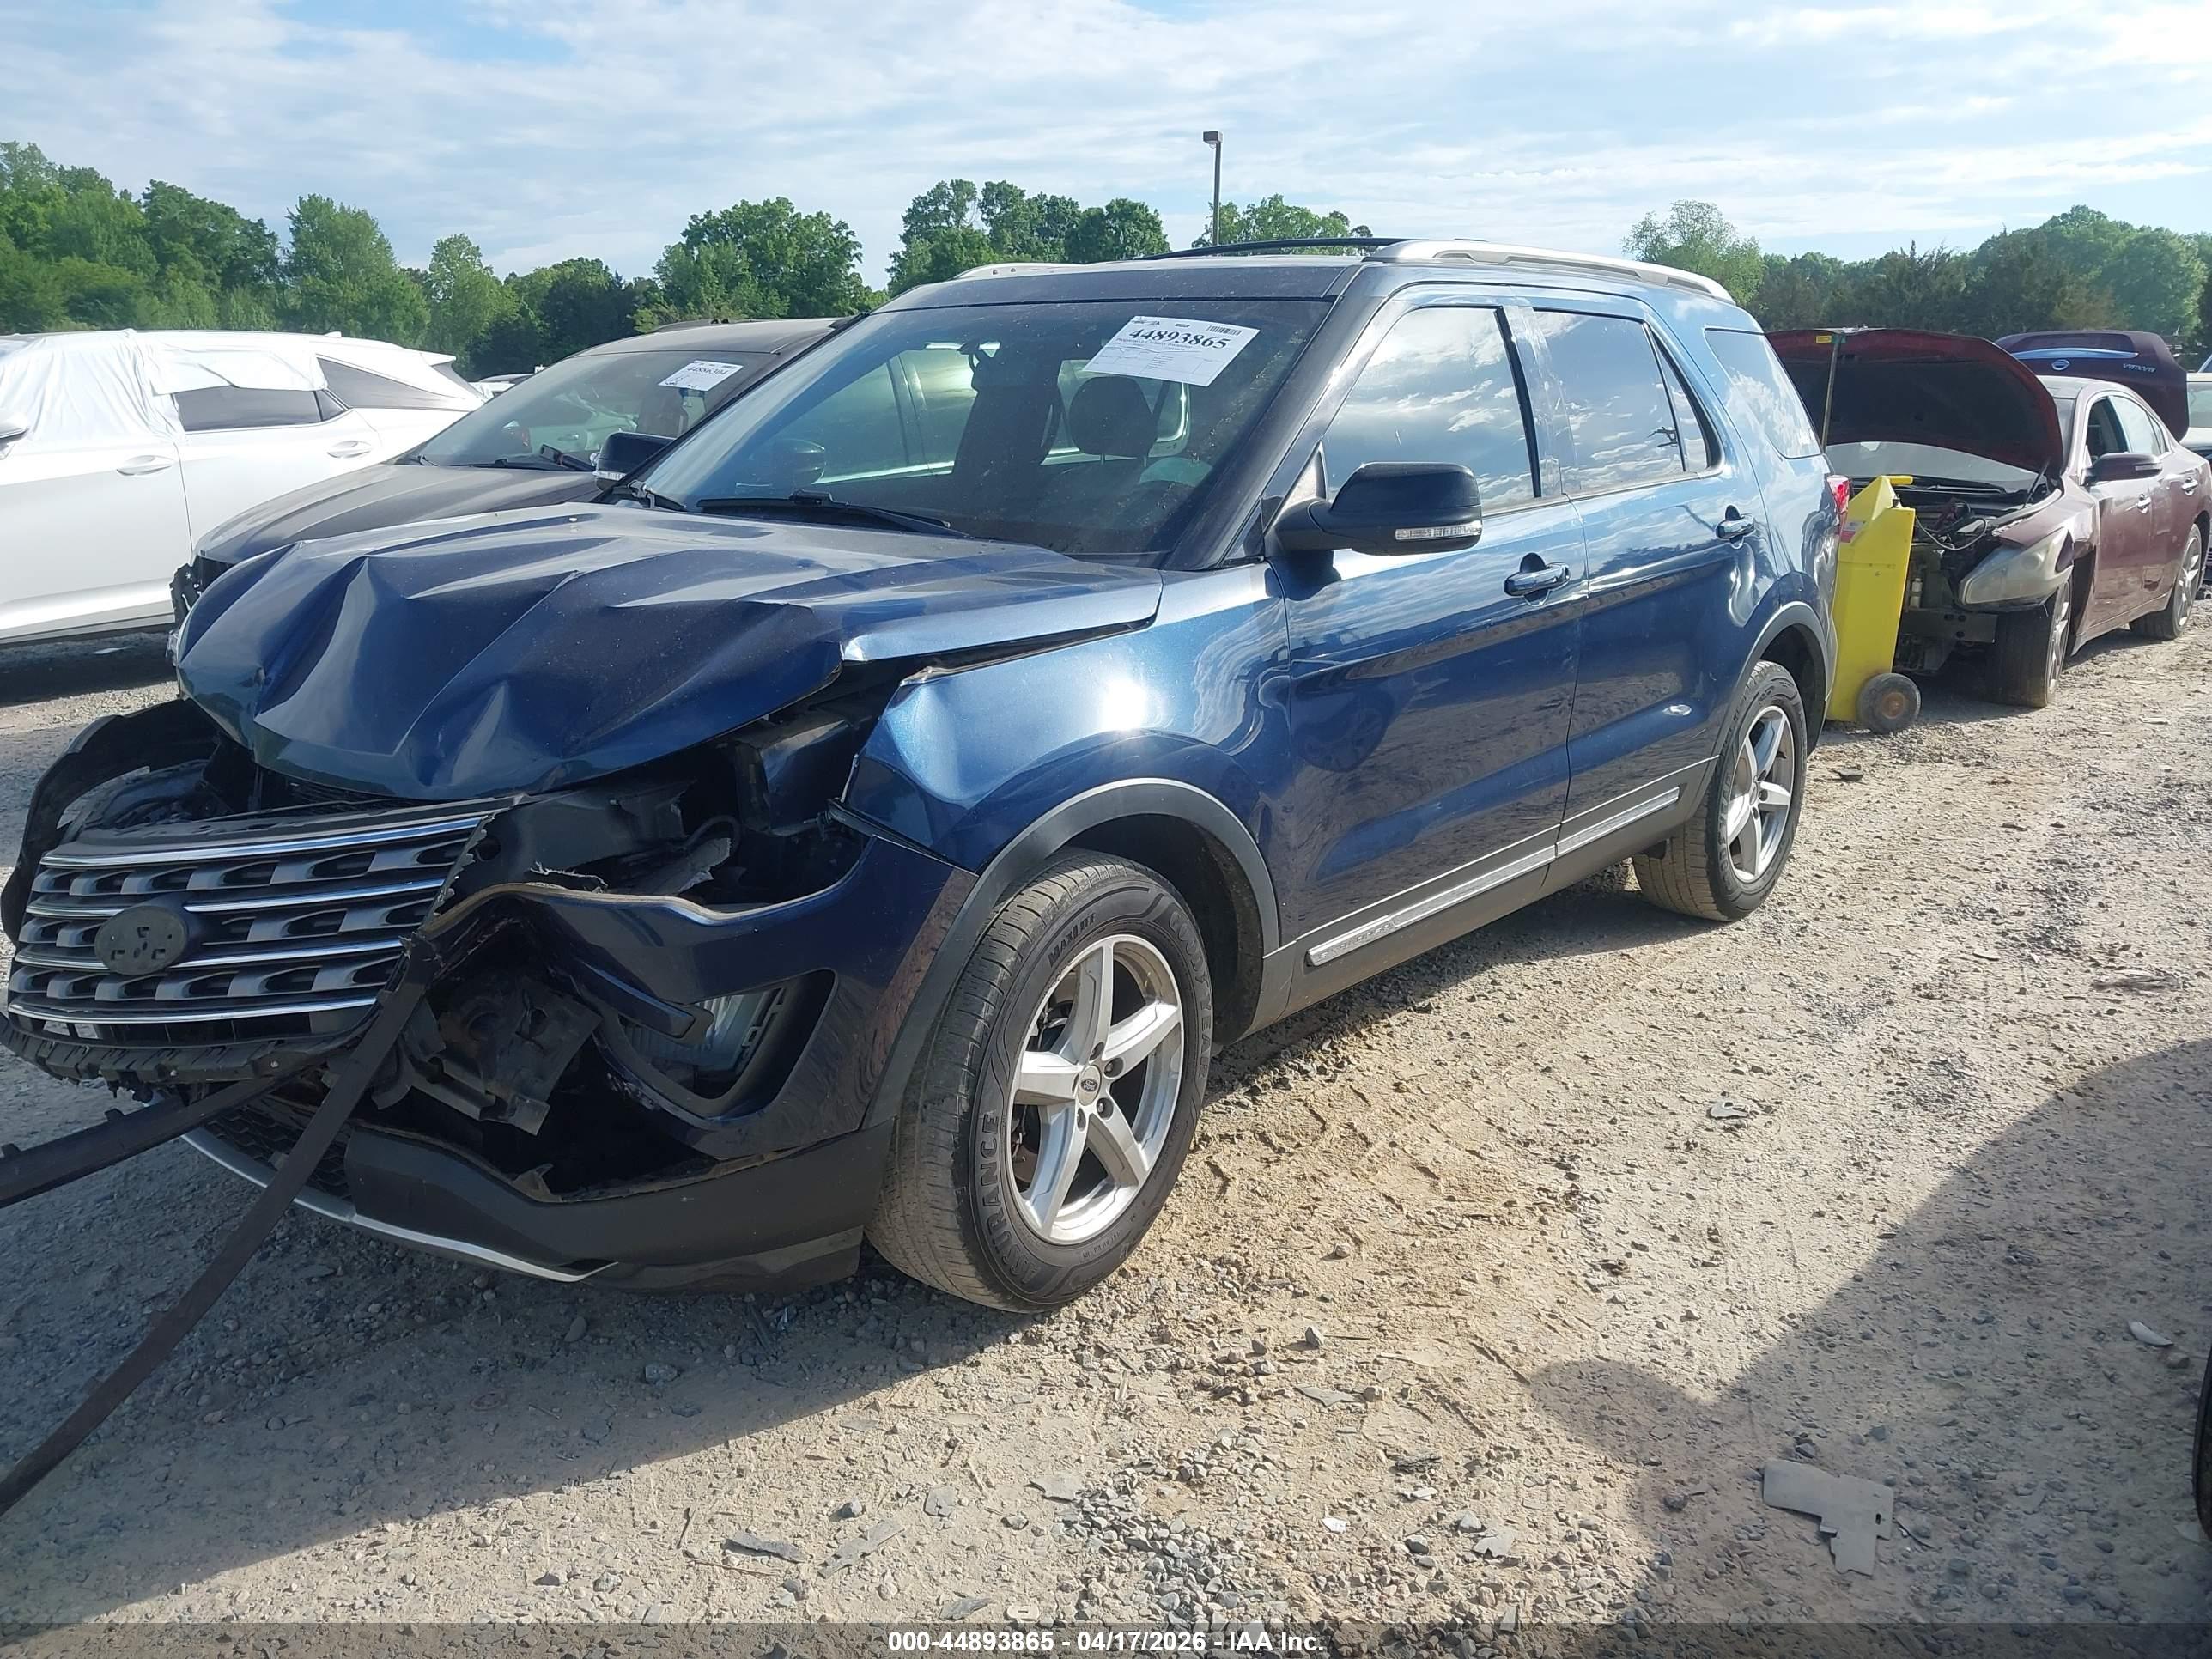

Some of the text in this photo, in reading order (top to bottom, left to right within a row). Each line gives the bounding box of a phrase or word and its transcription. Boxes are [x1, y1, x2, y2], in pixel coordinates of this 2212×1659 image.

[1129, 328, 1231, 349] 44893865
[1169, 910, 1212, 1079] GOODYEAR
[981, 1114, 1041, 1285] ASSURANCE
